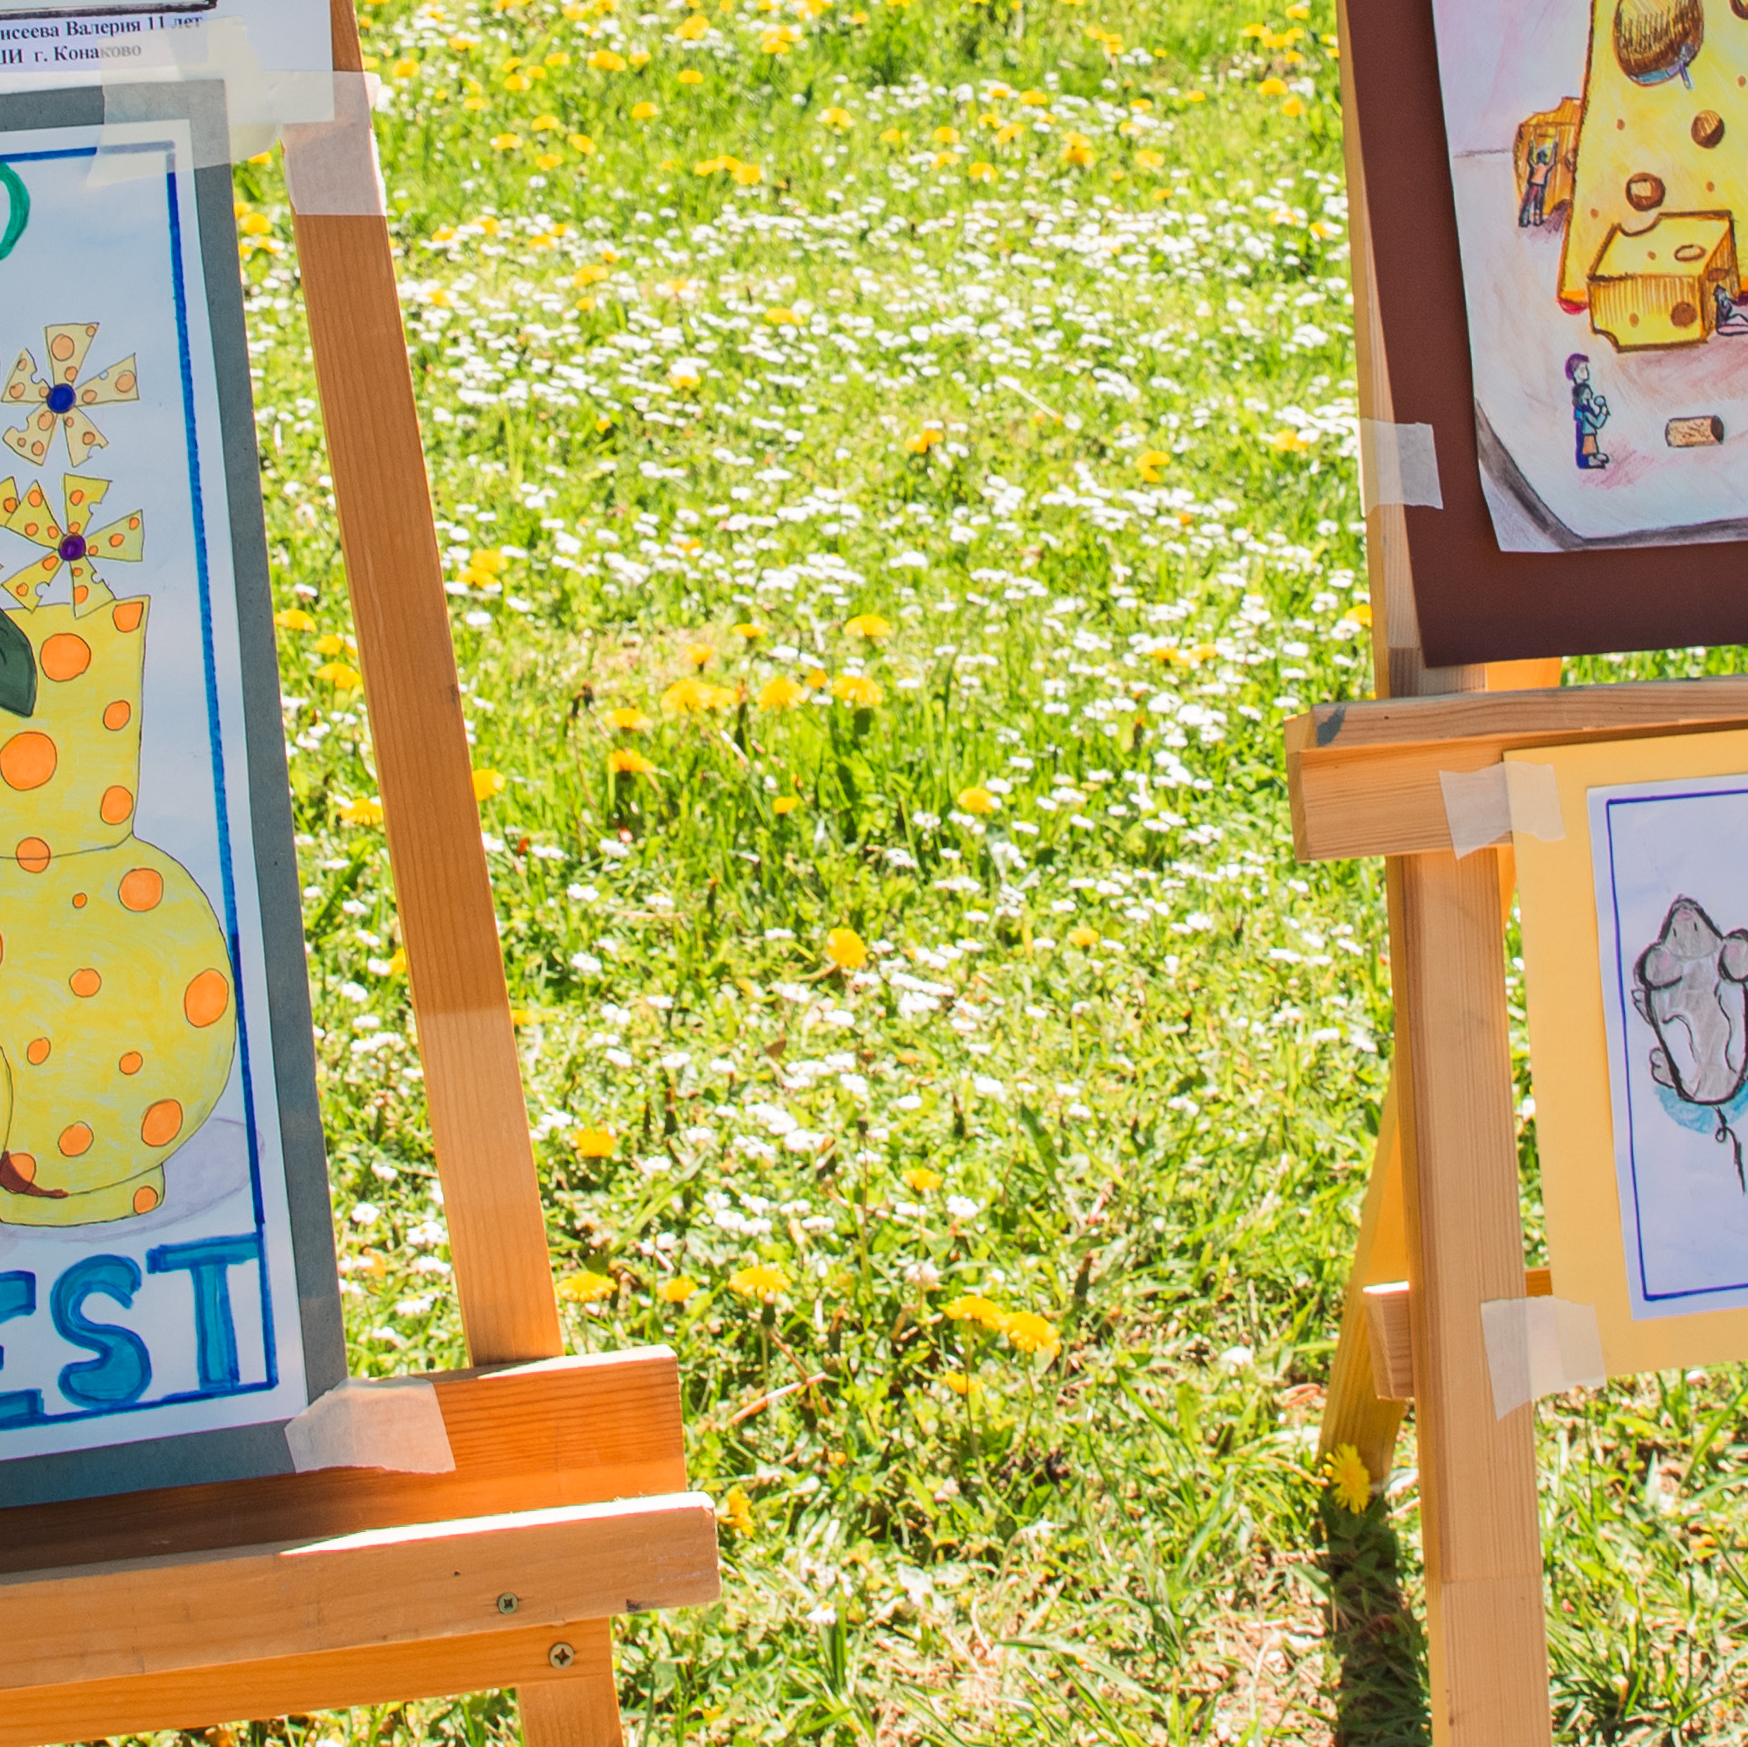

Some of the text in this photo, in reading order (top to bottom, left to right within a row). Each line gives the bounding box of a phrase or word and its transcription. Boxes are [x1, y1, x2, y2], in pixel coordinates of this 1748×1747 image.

[66, 19, 141, 39] Валерия
[147, 15, 164, 31] 11
[171, 16, 203, 30] лет
[34, 51, 48, 64] г.
[54, 45, 142, 62] Конаково
